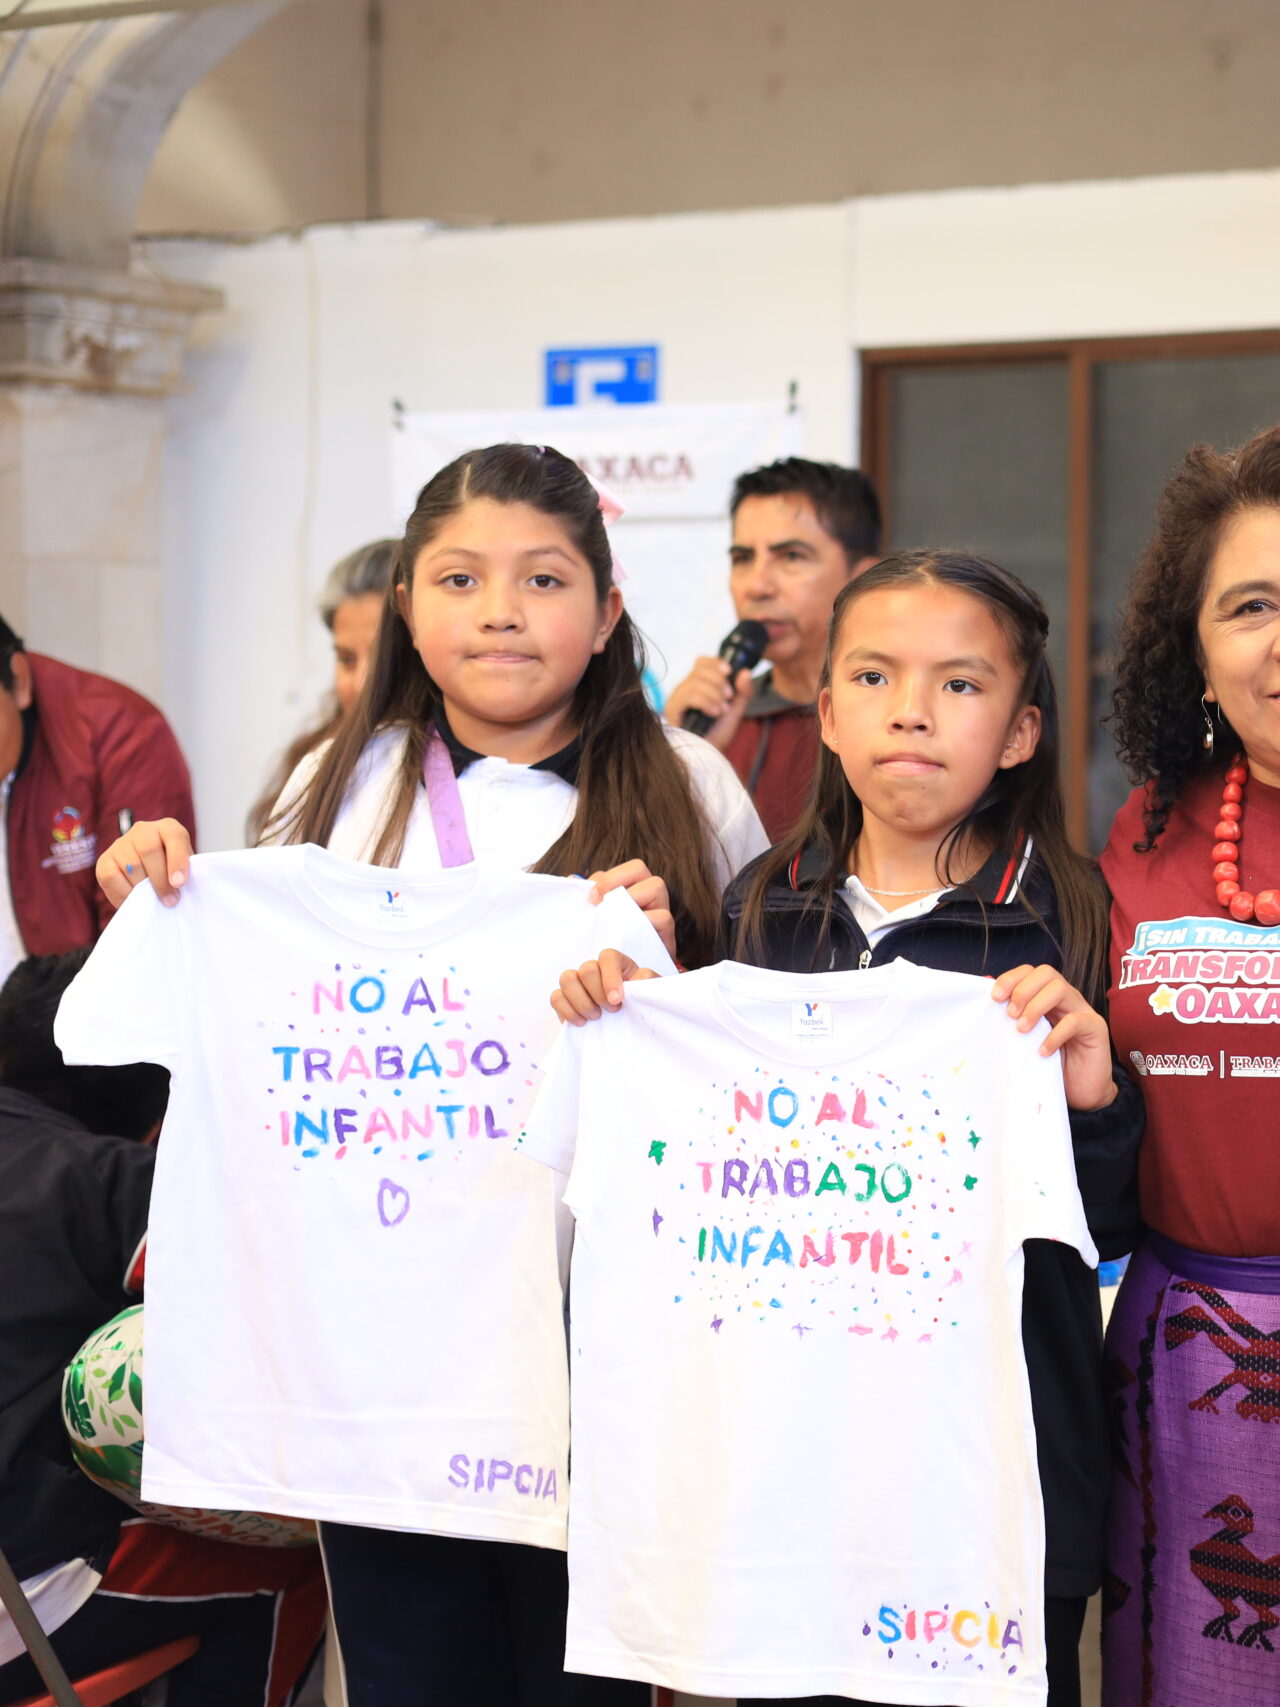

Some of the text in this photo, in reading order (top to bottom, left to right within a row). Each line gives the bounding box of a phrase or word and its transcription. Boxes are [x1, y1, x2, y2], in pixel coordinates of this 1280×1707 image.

[576, 454, 694, 483] XACA
[313, 976, 466, 1016] NO AL
[799, 1017, 825, 1026] Yazbek
[272, 1039, 511, 1083] TRABAJO
[1146, 1055, 1214, 1071] OAXACA
[280, 1104, 508, 1146] INFANTIL
[734, 1086, 879, 1129] NO AL
[696, 1158, 912, 1203] TRABAJO
[698, 1225, 909, 1275] INFANTIL
[447, 1453, 557, 1503] SIPCIA
[878, 1604, 1024, 1653] SIPCIA
